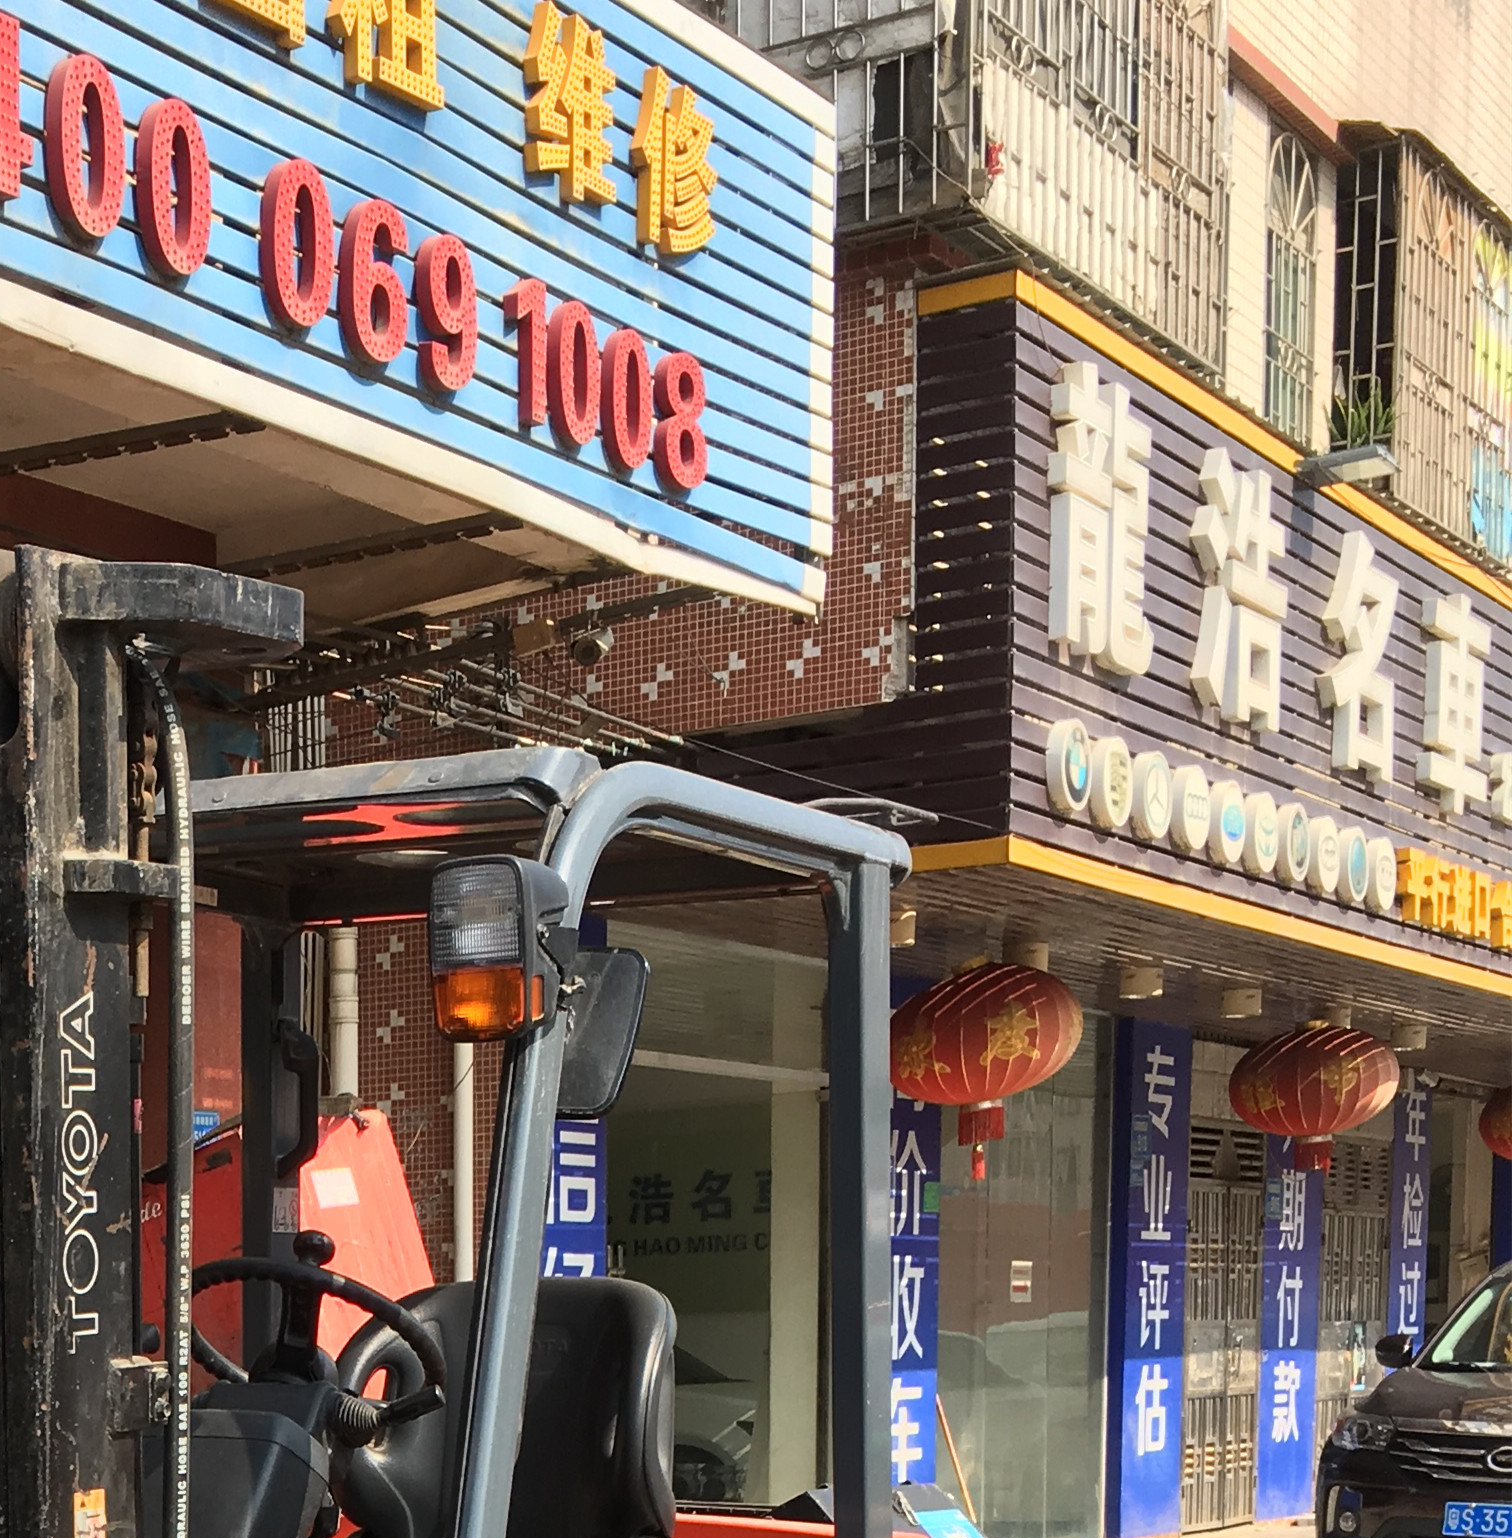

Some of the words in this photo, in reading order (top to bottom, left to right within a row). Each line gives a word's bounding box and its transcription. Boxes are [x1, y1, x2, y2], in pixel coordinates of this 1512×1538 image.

[523, 0, 716, 254] 维修
[260, 158, 478, 391] 069
[503, 278, 708, 491] 1008
[149, 669, 170, 697] SAE
[163, 703, 181, 744] HOSE
[173, 751, 190, 839] HYDRAULIC
[179, 847, 191, 913] BRAIDED
[180, 920, 191, 958] WIRE
[60, 990, 100, 1354] TOYOTA
[634, 1236, 680, 1257] HAO
[688, 1232, 747, 1255] MING
[1136, 1045, 1176, 1456] 专业评估
[1271, 1136, 1307, 1443] 期付款
[179, 1371, 189, 1396] 100
[178, 1404, 188, 1431] SAE
[177, 1437, 188, 1475] HOSE
